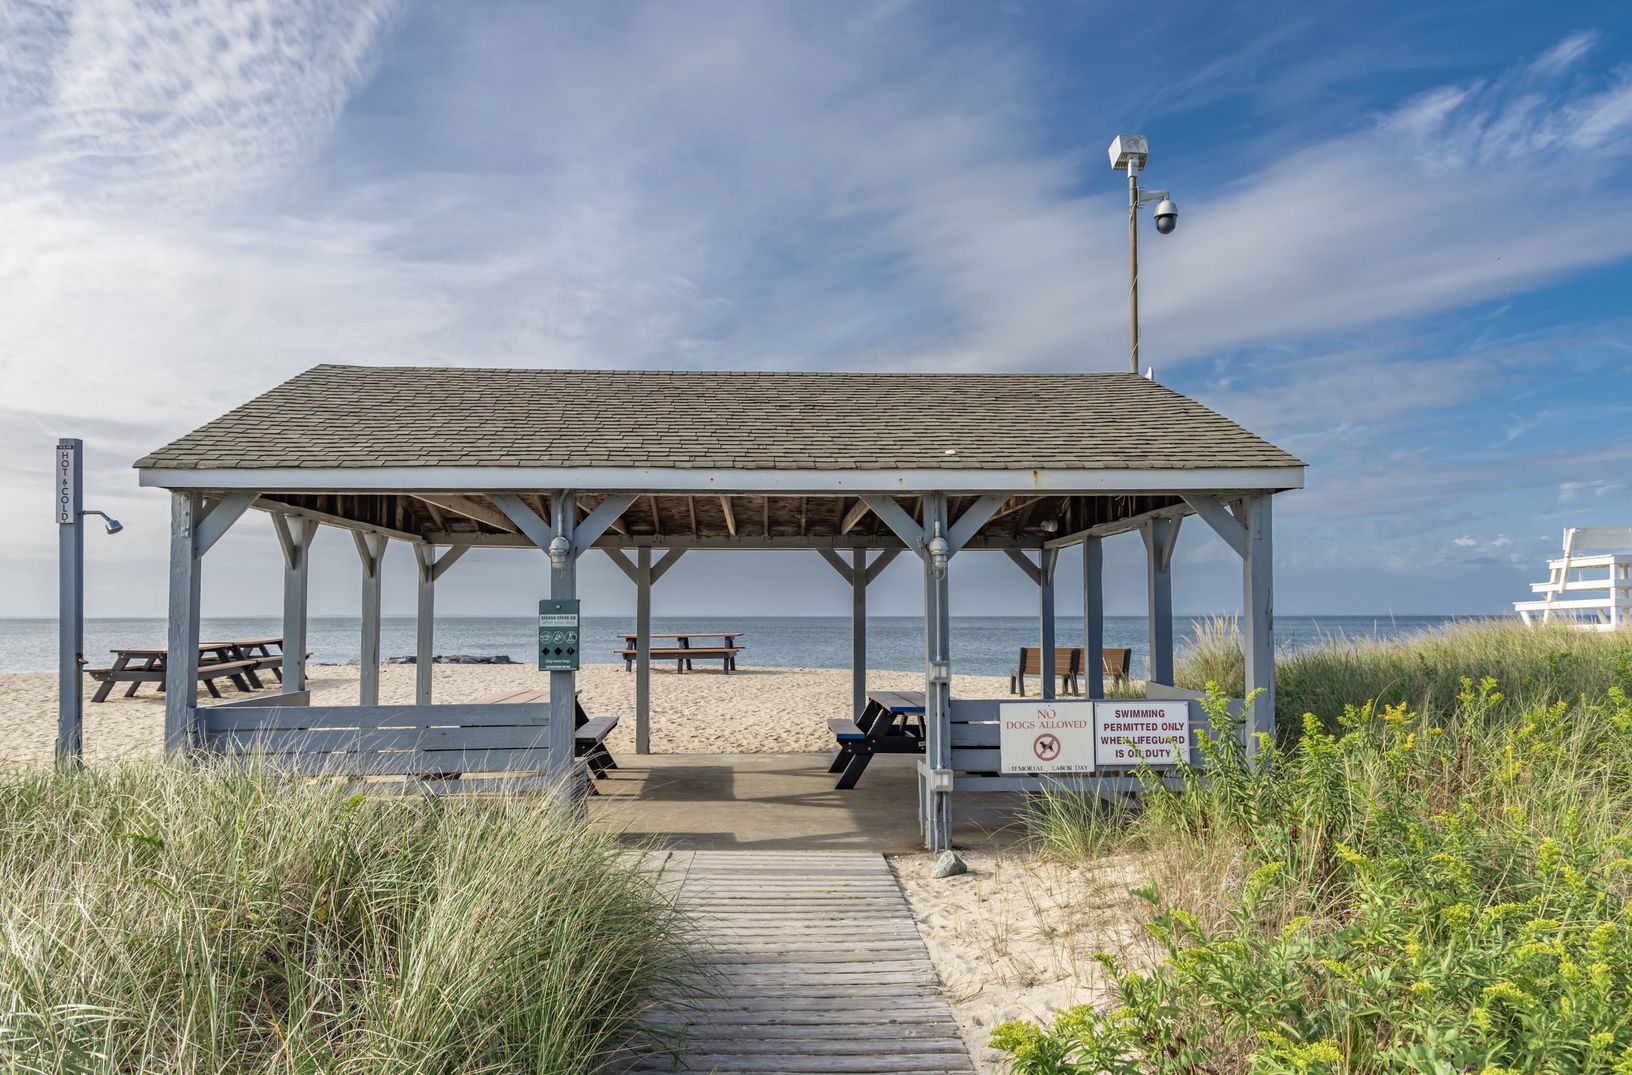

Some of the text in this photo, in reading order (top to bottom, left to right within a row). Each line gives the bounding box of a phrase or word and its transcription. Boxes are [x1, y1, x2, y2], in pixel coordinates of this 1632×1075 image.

[61, 452, 69, 476] HOT
[61, 488, 69, 520] COLD
[1037, 709, 1056, 719] NO
[1115, 709, 1165, 718] SWIMMING
[1006, 720, 1087, 730] DOGS ALLOWED
[1104, 722, 1185, 732] PERMITTED ONLY
[1132, 735, 1185, 745] LIFEGUARD
[1115, 749, 1125, 758] IS
[1145, 749, 1171, 758] DUTY
